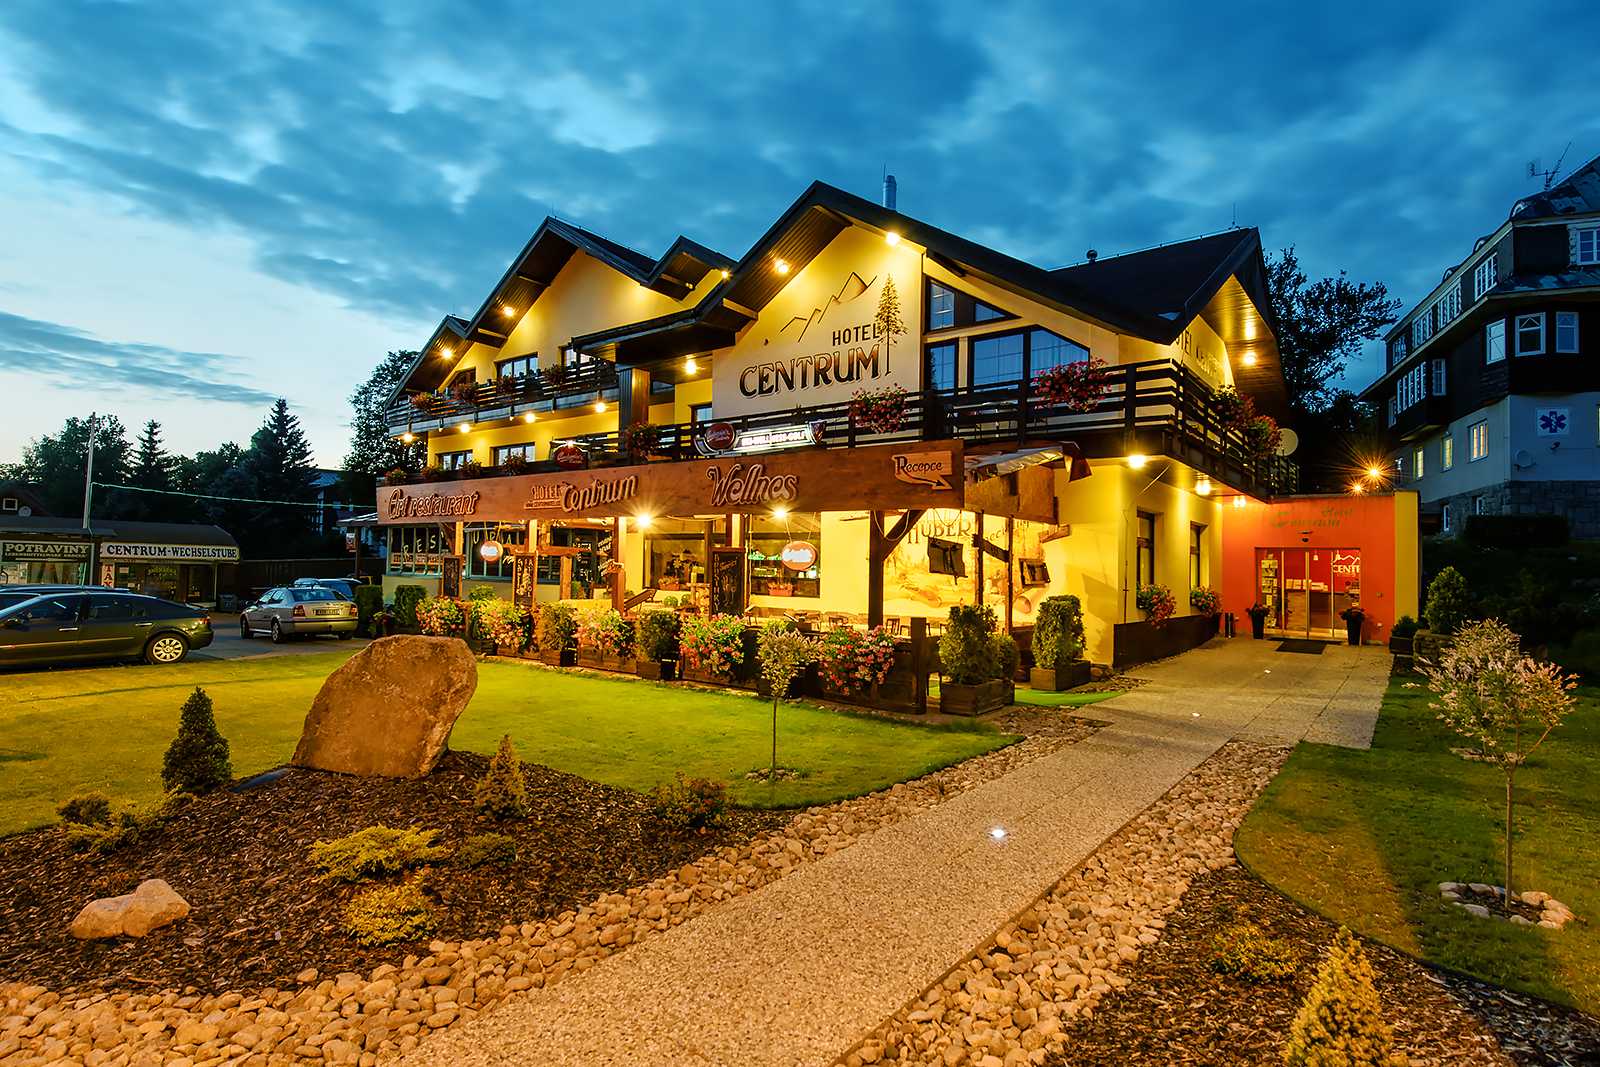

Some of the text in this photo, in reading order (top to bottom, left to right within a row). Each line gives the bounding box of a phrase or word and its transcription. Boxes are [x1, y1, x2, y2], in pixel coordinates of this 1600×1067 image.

[832, 324, 881, 346] HOTEL
[739, 344, 881, 398] CENTRUM
[894, 456, 943, 476] Recepce
[530, 484, 560, 500] HOTEL
[559, 475, 638, 512] Centrum
[706, 463, 799, 506] Wellnes
[387, 488, 480, 519] Art restaurant
[5, 543, 89, 554] POTRAVINY
